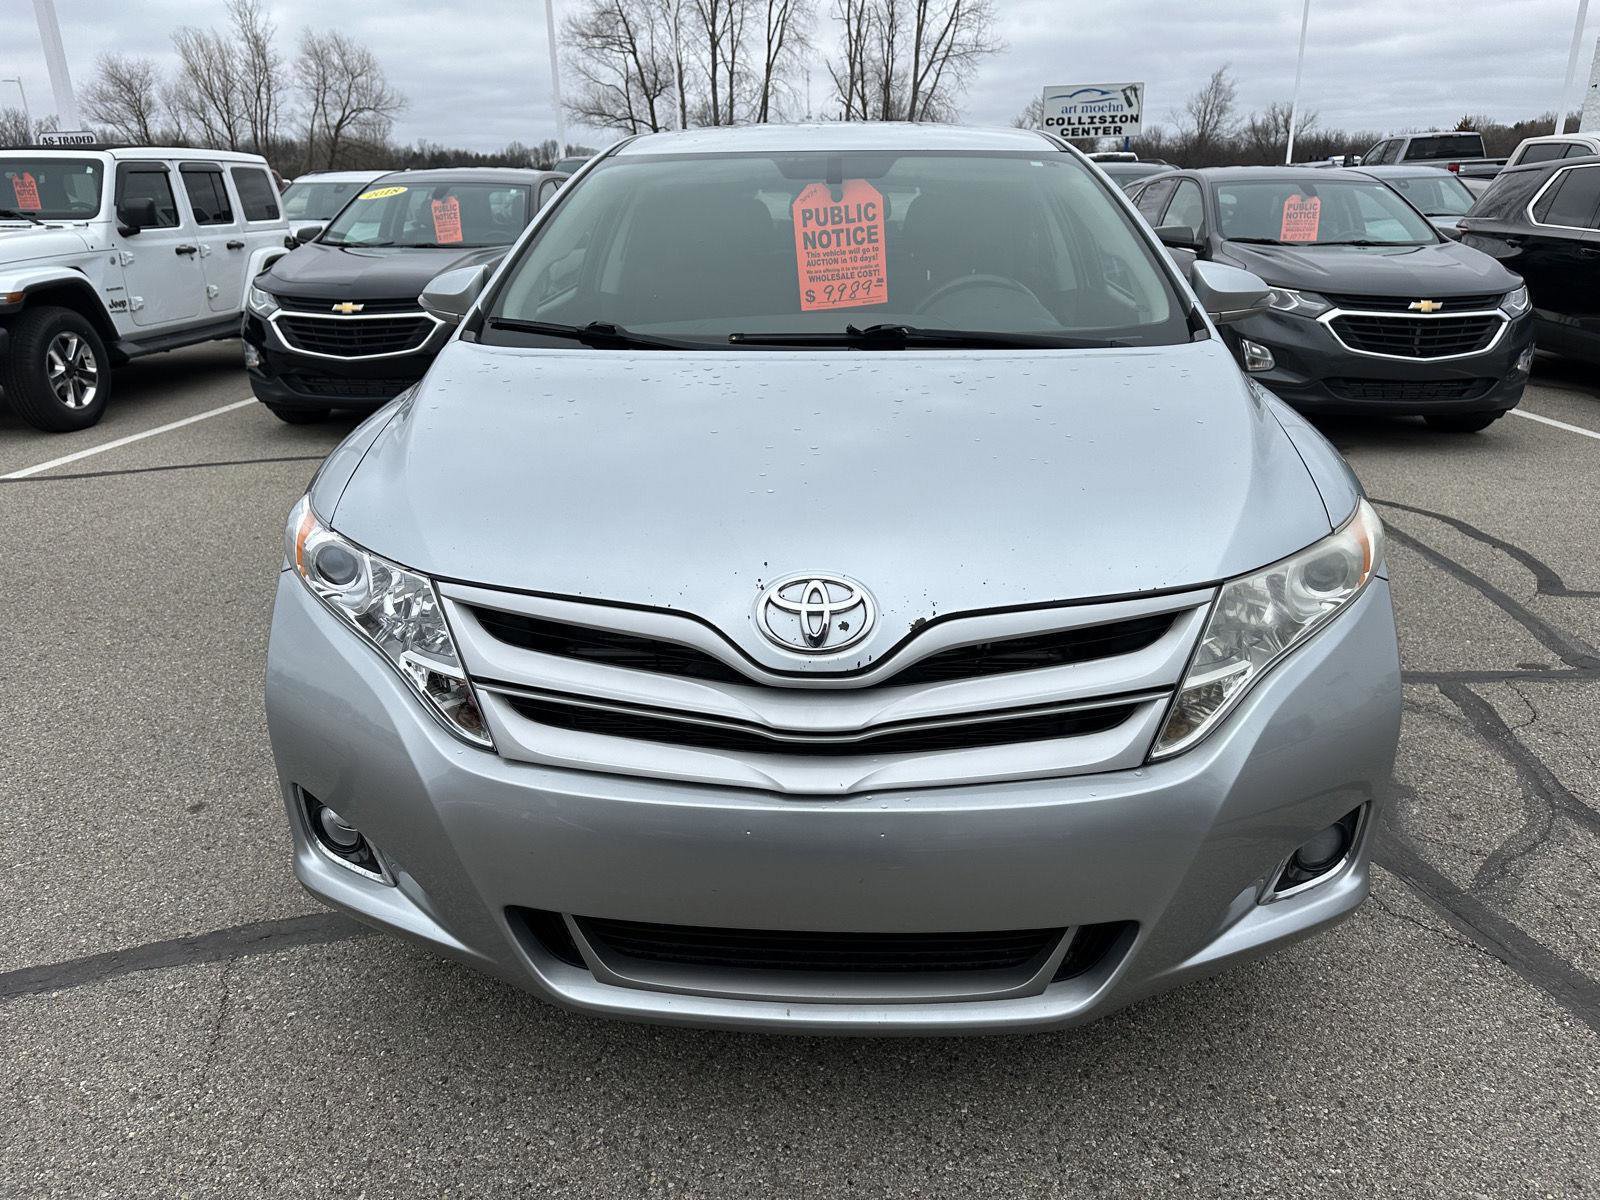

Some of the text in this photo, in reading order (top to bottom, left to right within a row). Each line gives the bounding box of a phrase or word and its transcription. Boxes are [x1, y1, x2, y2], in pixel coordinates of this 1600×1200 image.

[1061, 102, 1124, 114] art moehn
[1045, 114, 1139, 126] COLLISION
[1060, 126, 1123, 137] CENTER
[42, 136, 94, 145] AS-TRADED
[368, 188, 401, 197] 2018
[1287, 203, 1318, 211] PUBLIC
[435, 211, 459, 220] NOTICE
[801, 202, 877, 228] PUBLIC
[1286, 211, 1318, 219] NOTICE
[802, 225, 879, 250] NOTICE
[823, 249, 847, 257] vehicle
[848, 247, 861, 255] will
[806, 259, 839, 267] AUCTION
[859, 254, 879, 262] days!
[808, 269, 880, 283] WHOLESALE COST!
[805, 289, 816, 304] $
[109, 299, 127, 309] Jeep
